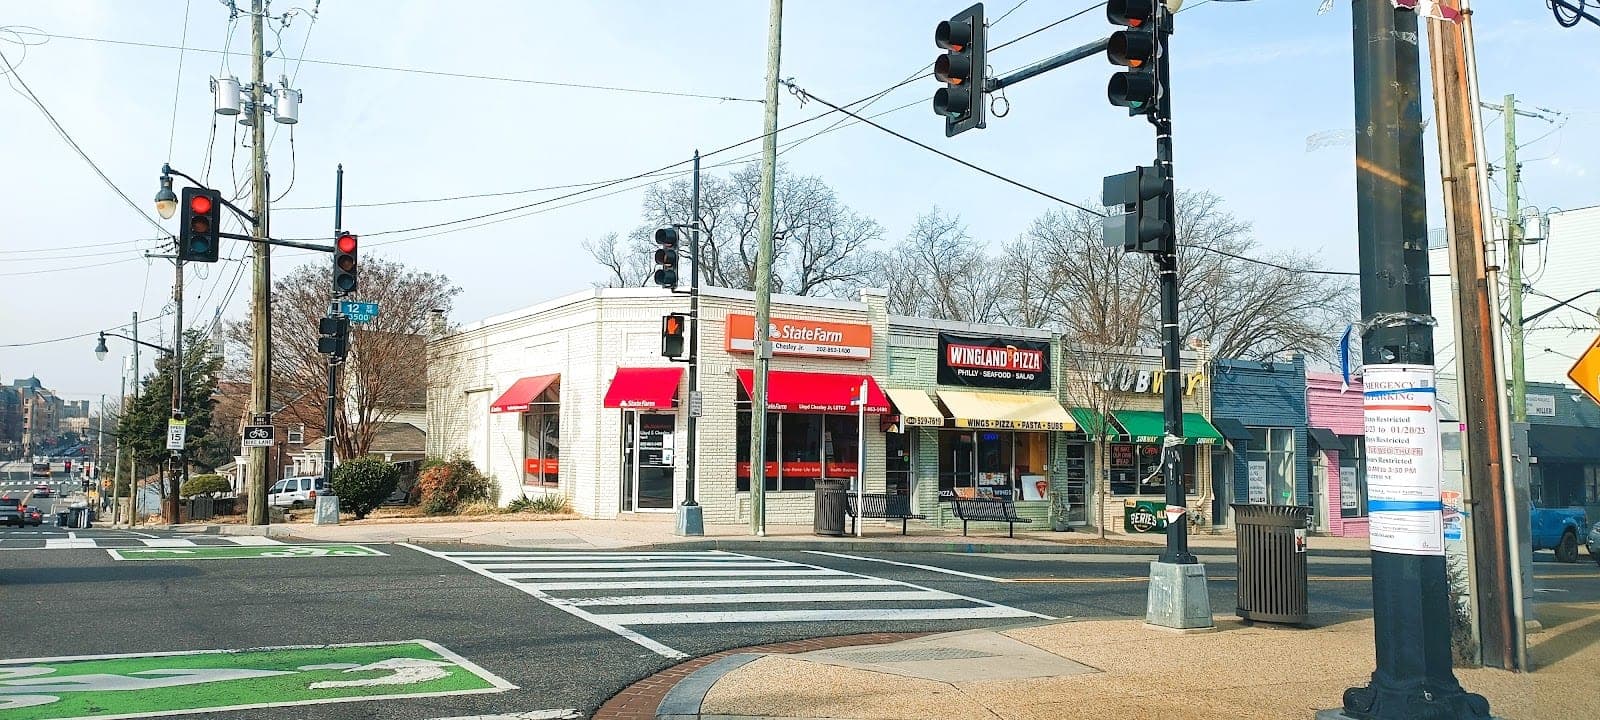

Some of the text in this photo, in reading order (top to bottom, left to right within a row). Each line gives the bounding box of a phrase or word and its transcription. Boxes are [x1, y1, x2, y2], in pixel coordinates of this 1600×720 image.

[347, 303, 360, 313] 12
[349, 313, 369, 321] 3500
[950, 346, 1008, 368] WINGLAND
[1013, 351, 1041, 370] PIZZA
[957, 368, 979, 377] PHILLY
[982, 371, 1012, 379] SEAFOOD
[1094, 363, 1205, 397] SUBWY
[1364, 381, 1416, 390] MERGENCY
[967, 419, 1064, 430] WINGS PIZZA PASTA SUBS
[1378, 425, 1386, 433] to
[171, 433, 182, 441] 15
[1135, 435, 1158, 443] SUBWAY
[1130, 512, 1157, 527] SERIES
